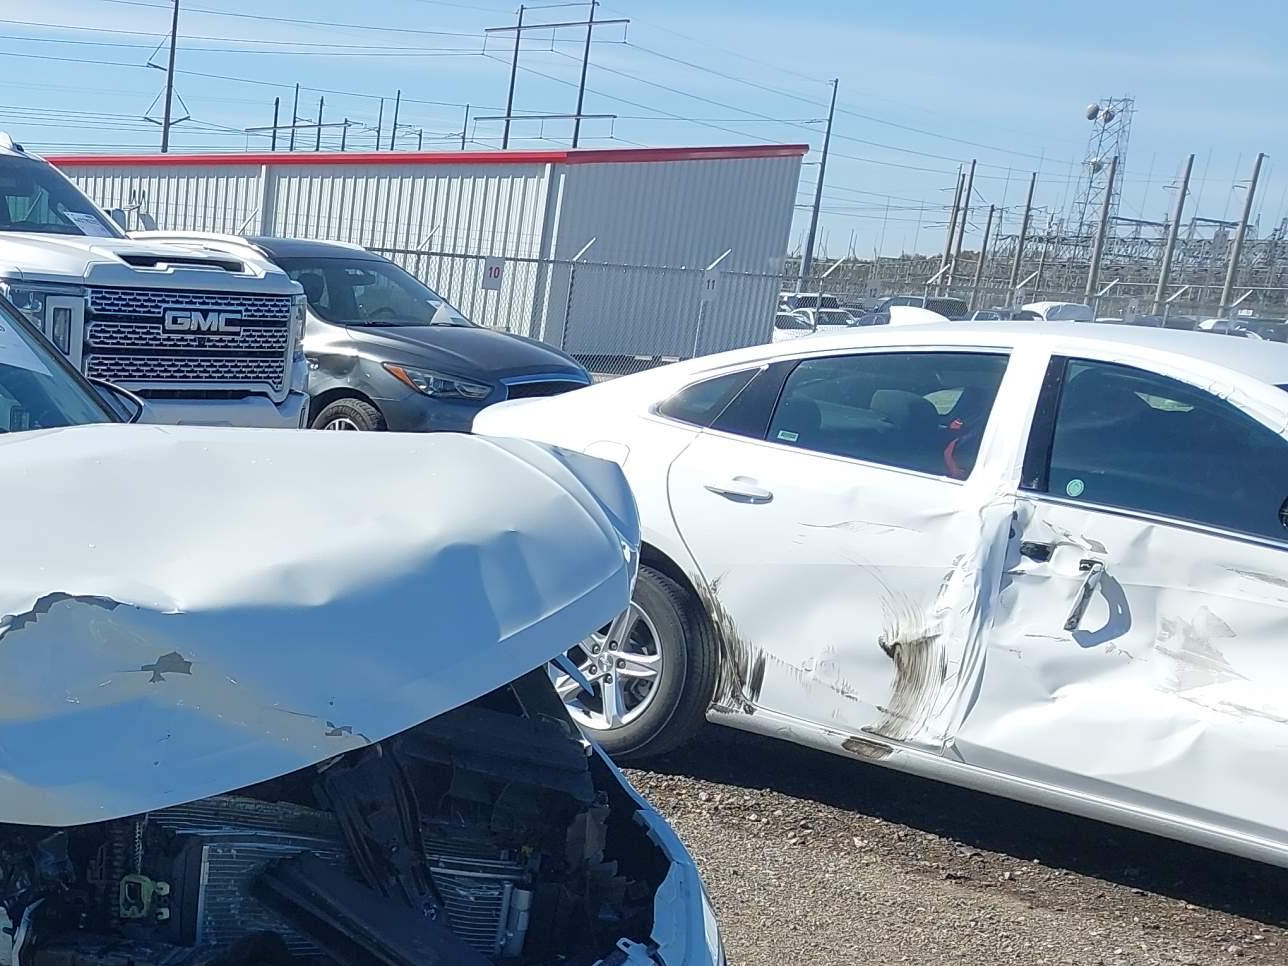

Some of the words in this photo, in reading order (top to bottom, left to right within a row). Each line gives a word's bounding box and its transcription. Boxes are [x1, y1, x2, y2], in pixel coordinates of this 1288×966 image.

[489, 266, 501, 279] 10
[706, 279, 716, 290] 11
[164, 311, 242, 332] GMC
